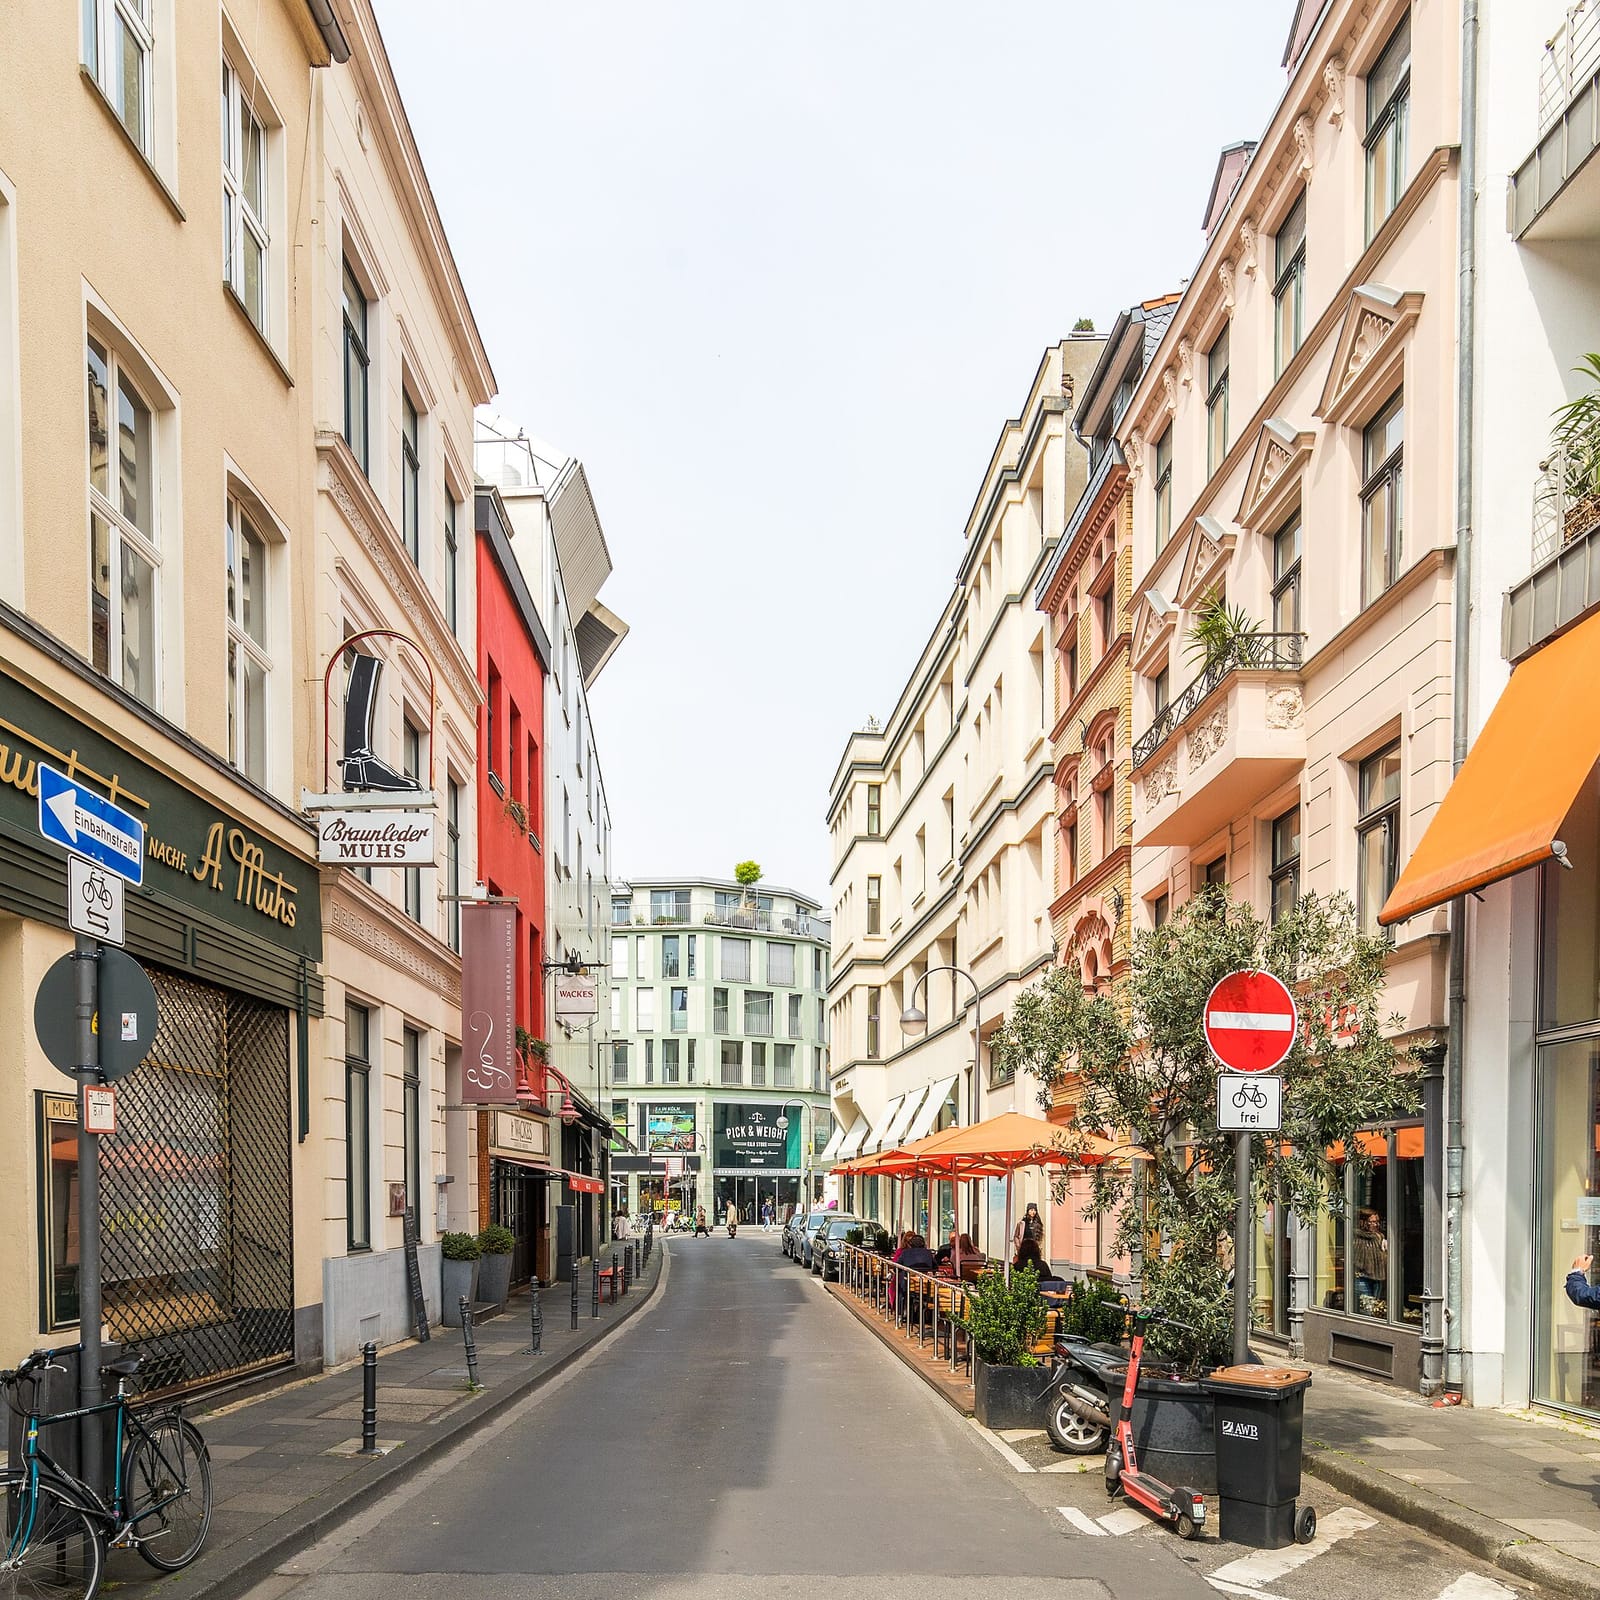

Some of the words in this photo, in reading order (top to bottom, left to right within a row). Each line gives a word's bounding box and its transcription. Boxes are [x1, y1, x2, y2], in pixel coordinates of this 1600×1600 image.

[74, 810, 138, 858] Einbahnstraße
[322, 818, 430, 842] Braunleder
[338, 843, 406, 858] MUHS
[148, 836, 189, 876] NACHF.
[192, 822, 224, 891] A.
[228, 828, 298, 928] Muhs
[559, 990, 594, 998] WACKES
[1240, 1111, 1260, 1123] frei
[725, 1125, 747, 1140] PICK
[748, 1123, 755, 1137] &
[756, 1125, 788, 1141] WEIGHT
[1234, 1422, 1258, 1437] AWB
